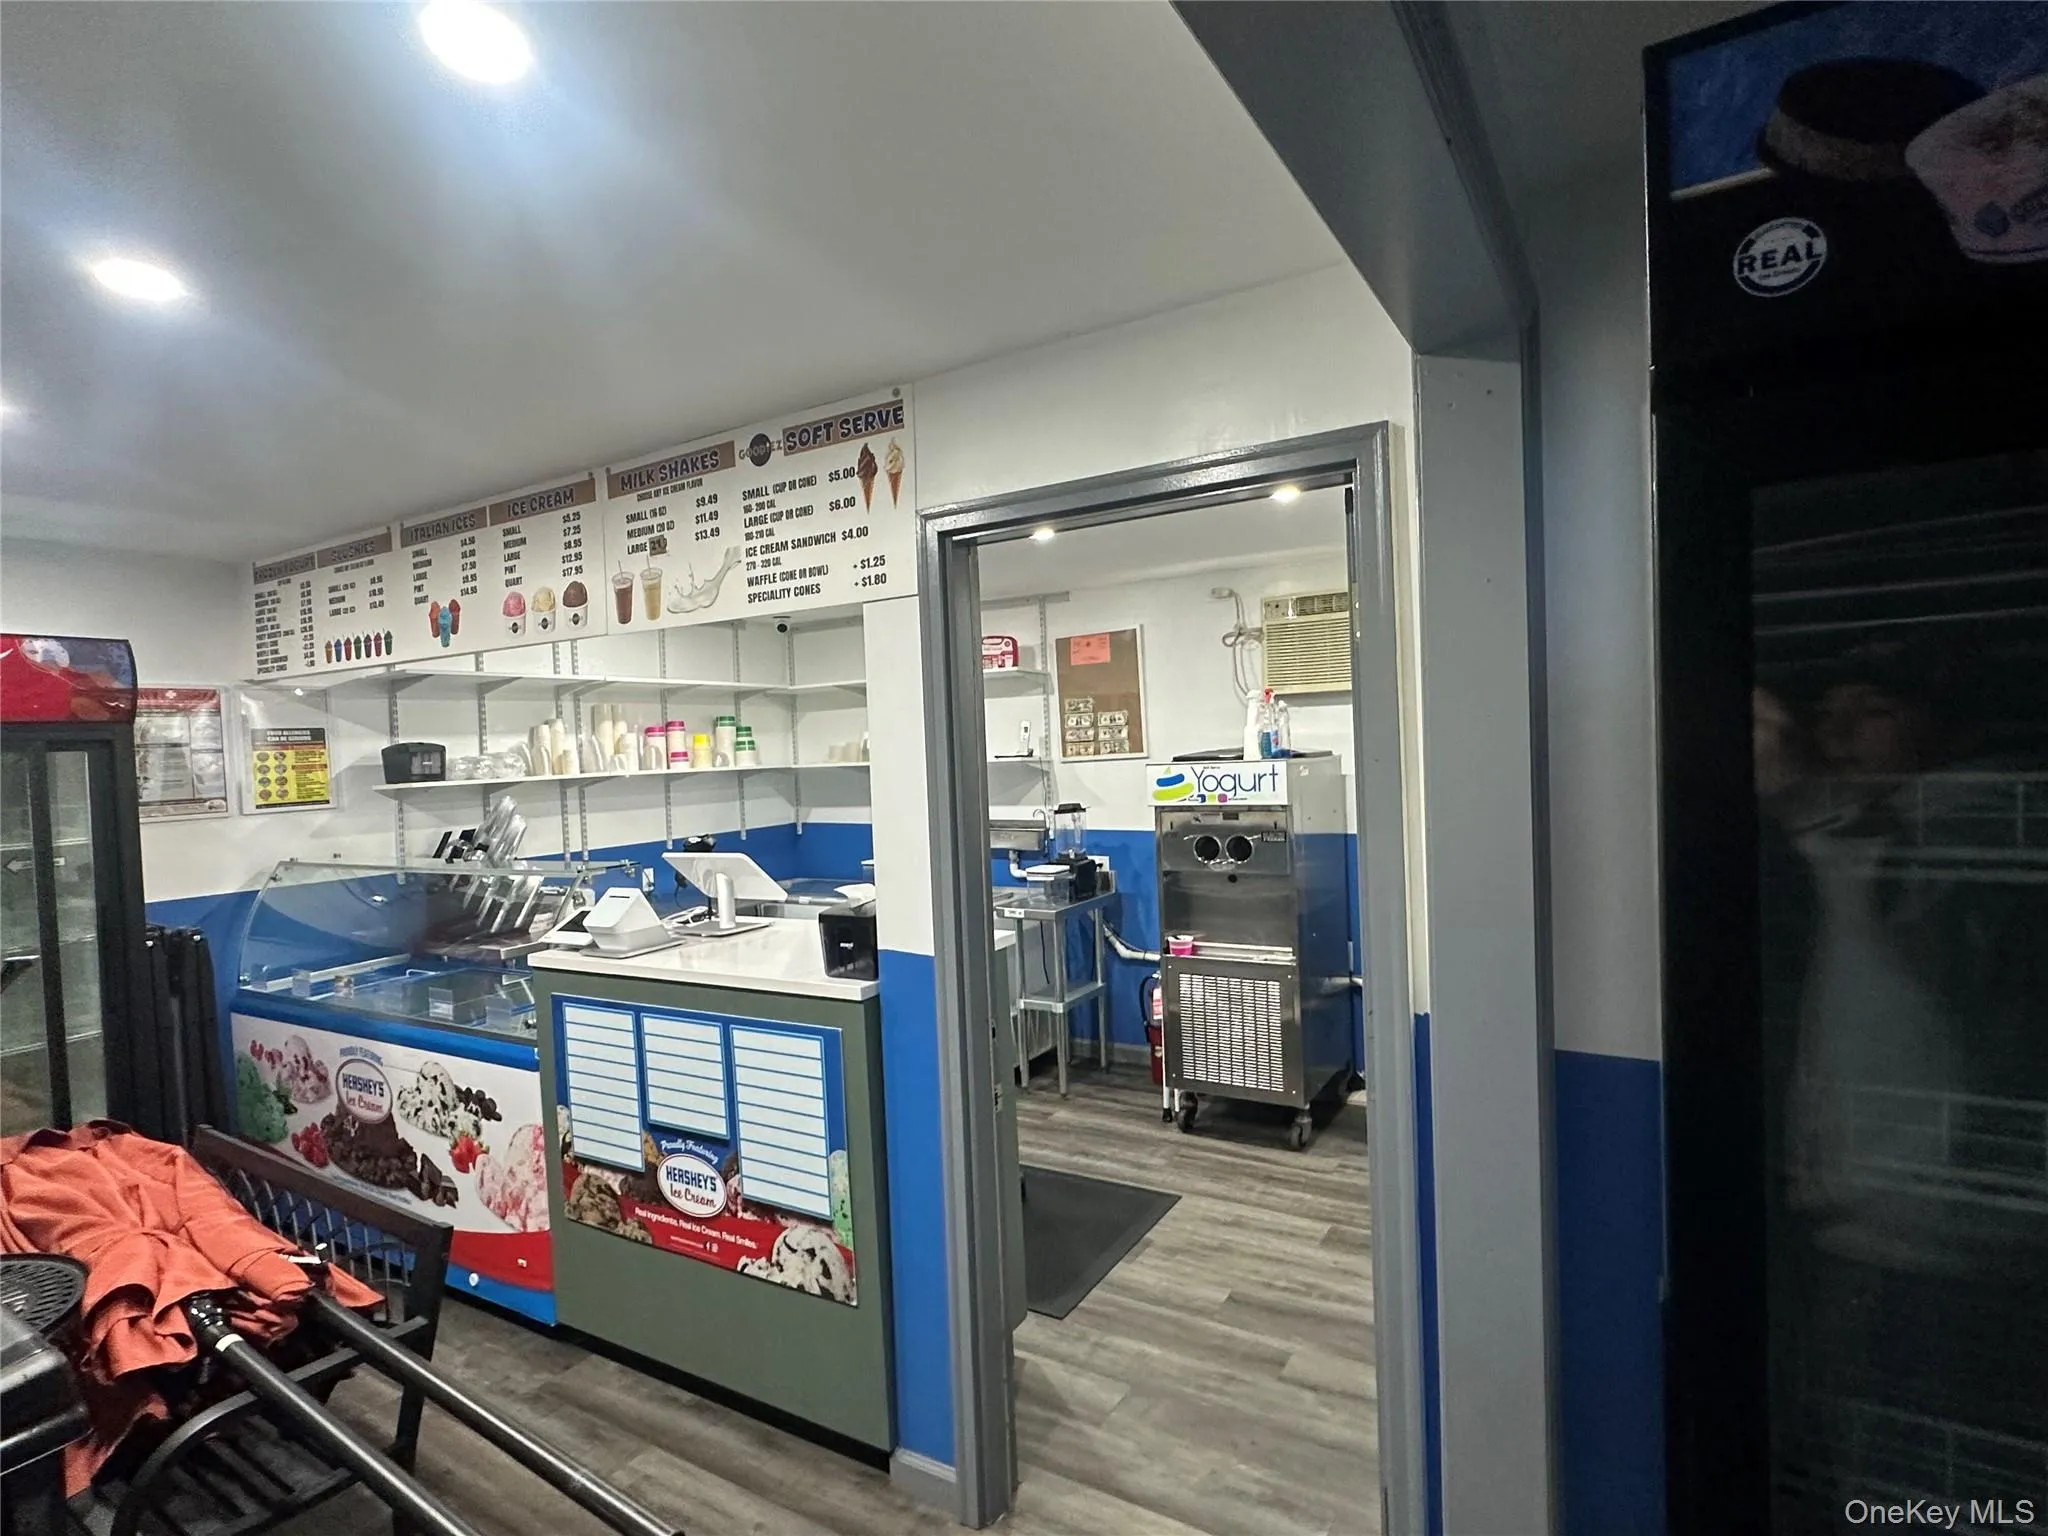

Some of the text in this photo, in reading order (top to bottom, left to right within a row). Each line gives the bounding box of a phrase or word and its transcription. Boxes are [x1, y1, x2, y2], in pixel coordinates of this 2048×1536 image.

[1737, 241, 1823, 275] REAL
[785, 405, 904, 451] SOFT SERVE
[620, 450, 720, 492] MILK SHAKES
[742, 486, 770, 502] SMALL
[828, 466, 856, 483] $5.00
[507, 487, 575, 518] ICE CREAM
[625, 510, 649, 524] SMALL
[695, 493, 718, 508] $9.49
[743, 514, 769, 529] LARGE
[828, 496, 857, 512] $6.00
[766, 499, 777, 510] CAL
[410, 513, 476, 542] ITALIAN ICES
[502, 511, 581, 537] SMALL $5.25
[503, 525, 581, 550] MEDIUM $7.25
[626, 525, 655, 539] MEDIUM
[695, 510, 719, 525] $11.49
[765, 527, 775, 537] CAL
[503, 538, 582, 563] LARGE $8.95
[627, 541, 648, 555] LARGE
[694, 526, 720, 541] $13.49
[745, 525, 869, 558] ICE CREAM SANDWICH $4.00
[504, 551, 583, 575] PINT $12.95
[504, 565, 584, 588] QUART $17.95
[747, 572, 777, 587] WAFFLE
[779, 568, 798, 582] (CONE
[798, 567, 808, 580] OR
[808, 563, 829, 577] BOWL)
[860, 554, 886, 570] $1.25
[747, 587, 792, 604] SPECIALITY
[793, 583, 822, 598] CONES
[861, 572, 887, 588] $1.80
[1189, 763, 1280, 798] Yogurt
[342, 1072, 385, 1098] HERSHEY'S
[660, 1138, 719, 1165] Proudly Featuring
[665, 1165, 718, 1193] HERSHEY'S
[669, 1183, 717, 1209] Ice Cream
[679, 1219, 692, 1230] Real
[691, 1223, 701, 1233] Ice
[721, 1231, 736, 1243] Real
